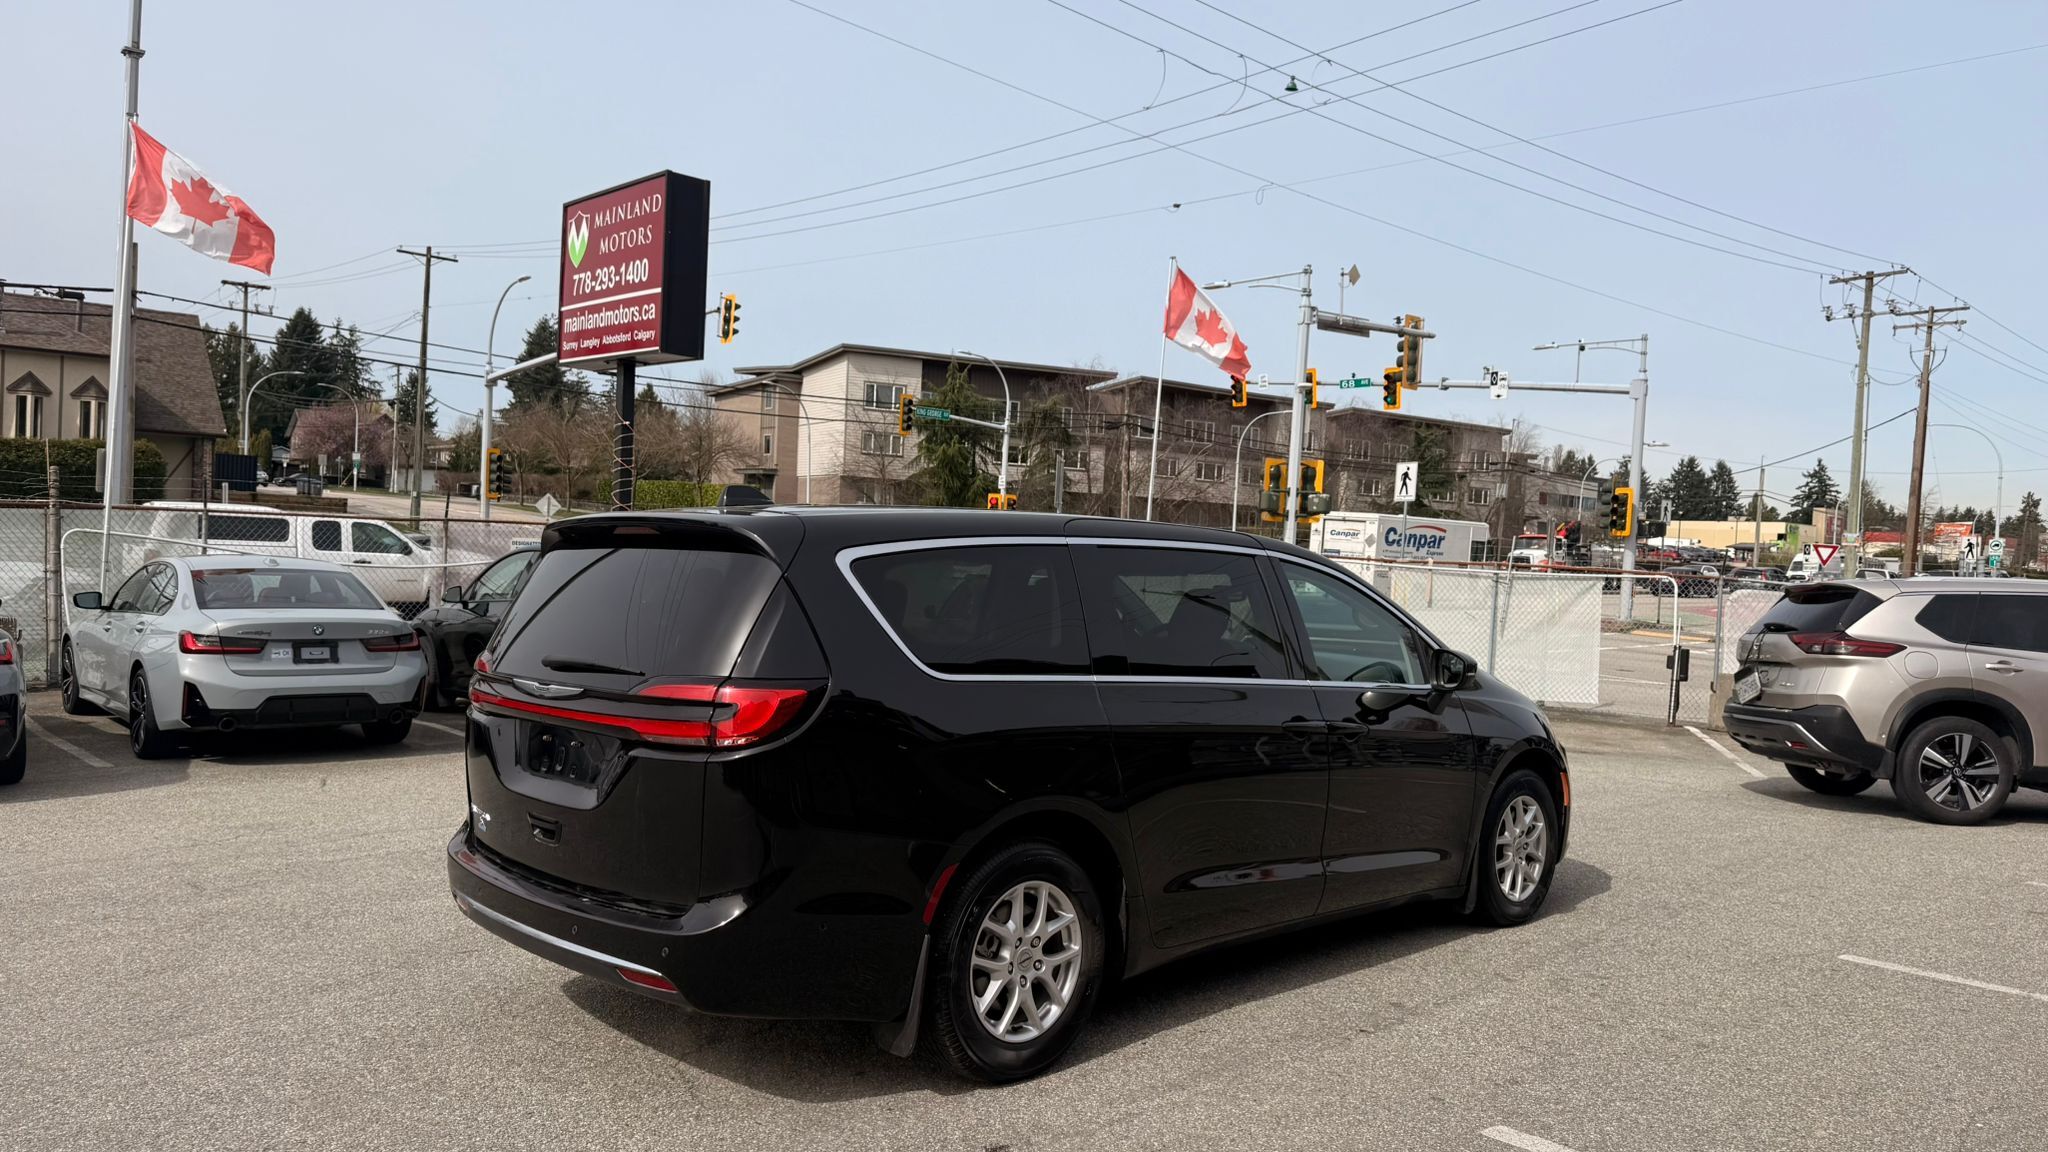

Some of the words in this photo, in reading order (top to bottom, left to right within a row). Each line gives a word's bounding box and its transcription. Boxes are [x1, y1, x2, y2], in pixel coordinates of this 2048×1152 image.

[594, 193, 662, 229] MAINLAND
[599, 224, 653, 255] MOTORS
[573, 258, 649, 297] 778-293-1400
[564, 303, 656, 333] mainlandmotors.ca
[562, 341, 579, 351] Surrey
[580, 337, 600, 349] Langley
[602, 331, 632, 345] Abbotsford
[633, 329, 656, 342] Calgary
[1342, 380, 1355, 388] 68
[1330, 529, 1360, 538] Canpar
[1384, 527, 1446, 551] Canpar
